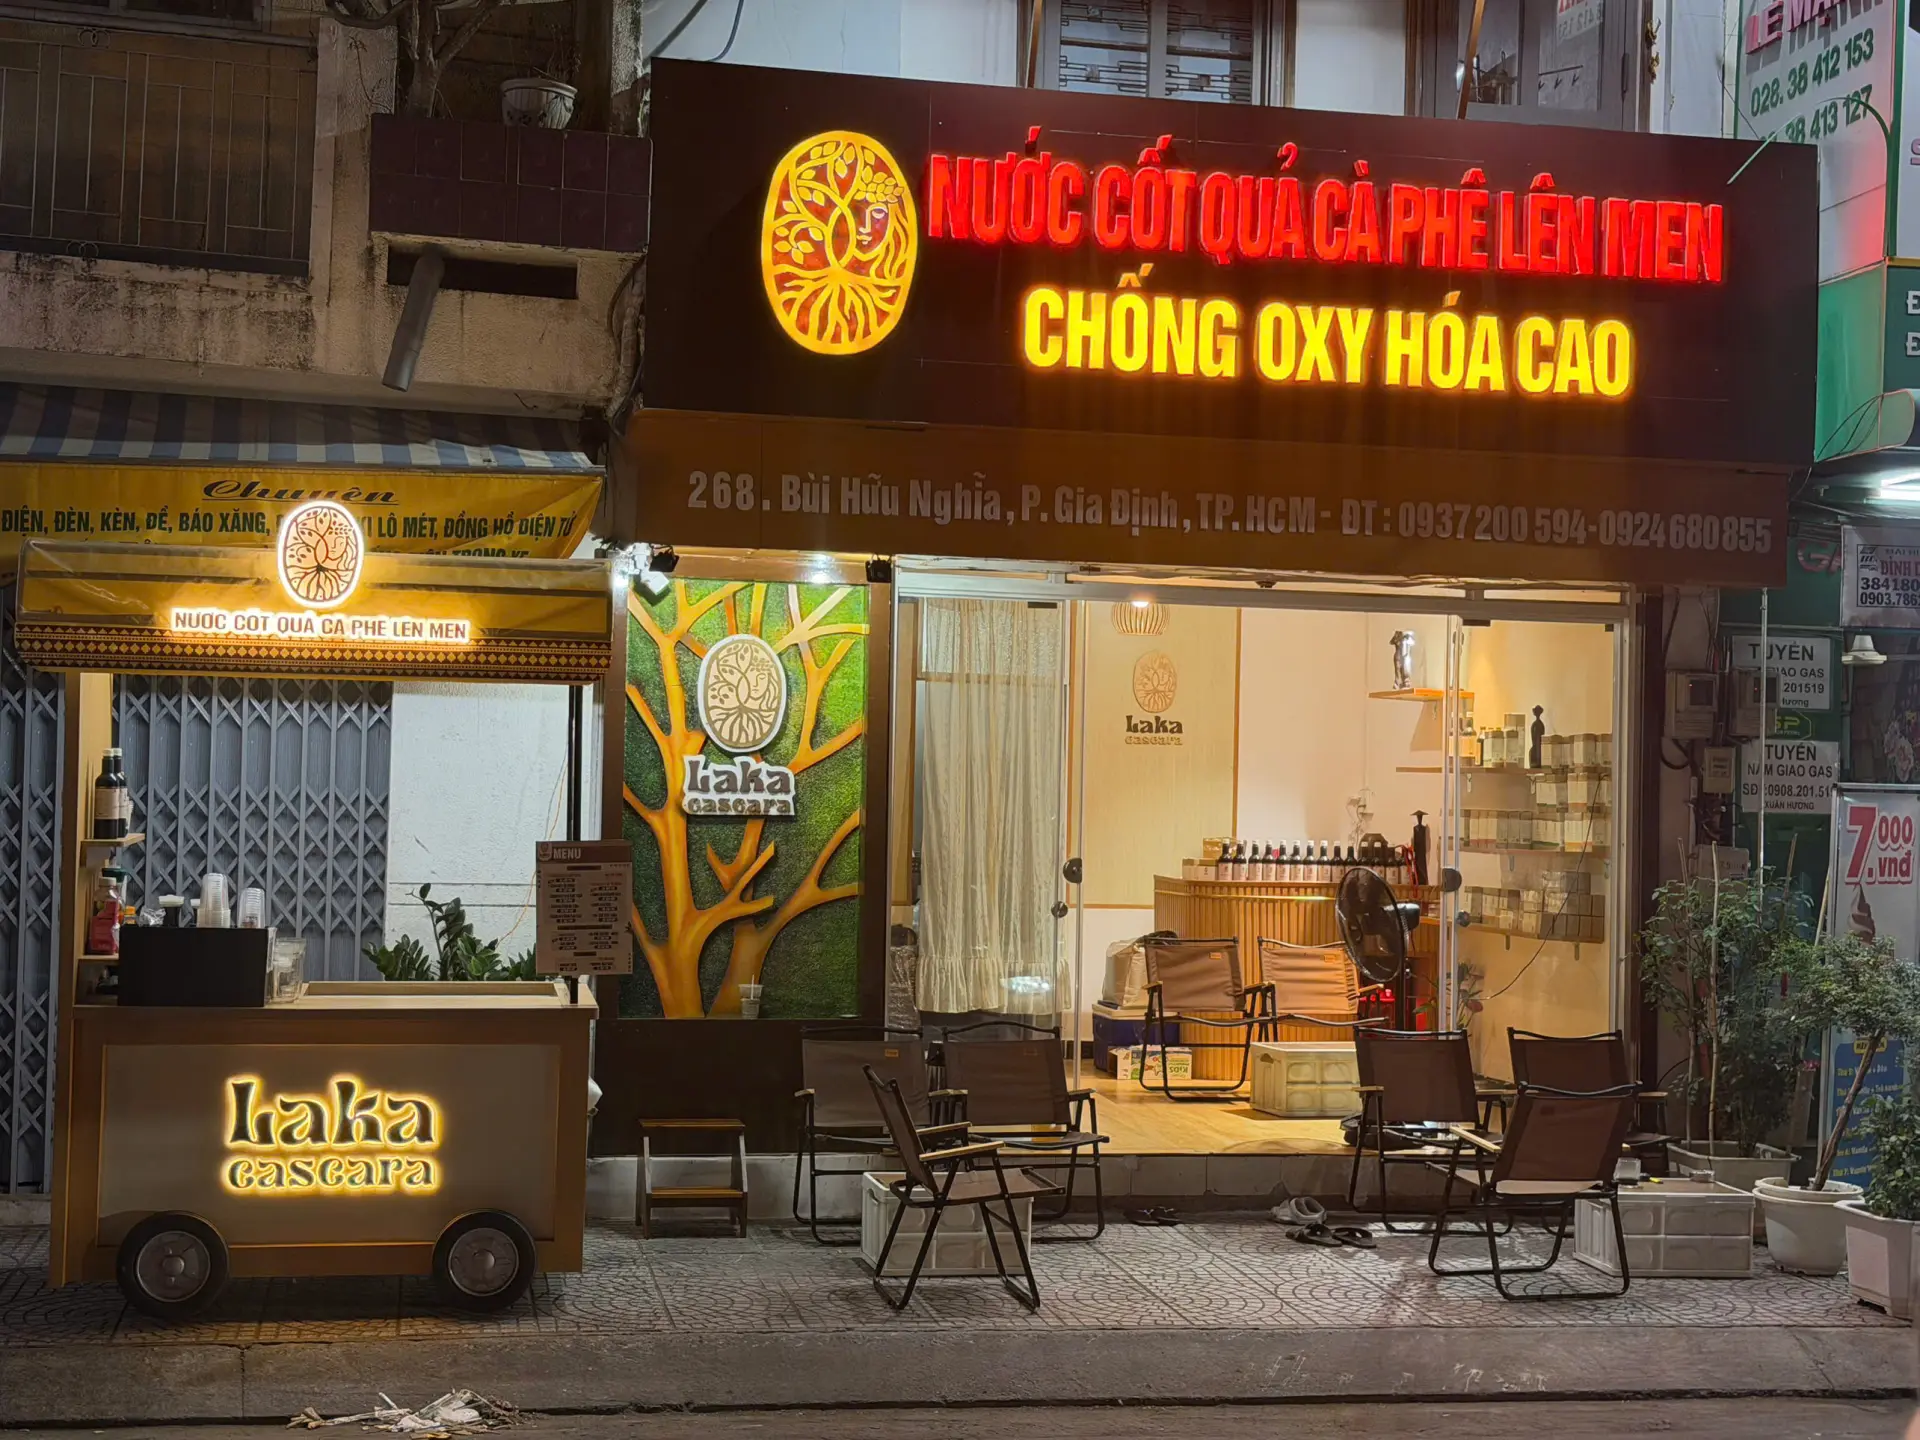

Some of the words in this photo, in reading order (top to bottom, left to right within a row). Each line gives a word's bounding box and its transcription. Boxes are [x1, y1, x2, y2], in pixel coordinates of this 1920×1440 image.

[1750, 78, 1784, 118] 028.
[1786, 61, 1809, 101] 38
[1811, 46, 1841, 88] 412
[1846, 27, 1874, 74] 153
[1809, 97, 1838, 140] 413
[1844, 84, 1874, 126] 127
[928, 125, 1083, 246] NƯỚC
[1094, 134, 1197, 252] CỐT
[1200, 142, 1307, 264] QUẢ
[1313, 159, 1383, 264] CÀ
[1388, 167, 1490, 270] PHÊ
[1498, 172, 1595, 275] LÊN
[1602, 198, 1723, 282] MEN
[1023, 263, 1239, 379] CHỐNG
[1256, 300, 1373, 384] OXY
[1385, 290, 1506, 391] HÓA
[1515, 316, 1632, 397] CAO
[781, 472, 830, 515] Bùi
[840, 472, 900, 517] Hữu
[1054, 485, 1103, 526] Gia
[1, 505, 49, 537] ĐIỆN,
[53, 506, 95, 534] ĐÈN,
[100, 507, 141, 532] KÈN,
[178, 507, 214, 533] BÁO
[218, 509, 271, 536] XĂNG,
[377, 512, 398, 538] LÔ
[402, 510, 439, 541] MÉT,
[518, 512, 557, 539] ĐIỆN
[1860, 591, 1920, 606] 0903.786
[429, 621, 466, 640] MEN
[1799, 667, 1825, 678] GAS
[686, 759, 792, 795] Laka
[1777, 764, 1806, 777] GIAO
[1808, 765, 1833, 778] GAS
[686, 797, 792, 814] cascara
[553, 848, 581, 860] MENU
[228, 1080, 437, 1146] Laka
[227, 1158, 435, 1189] cascara
